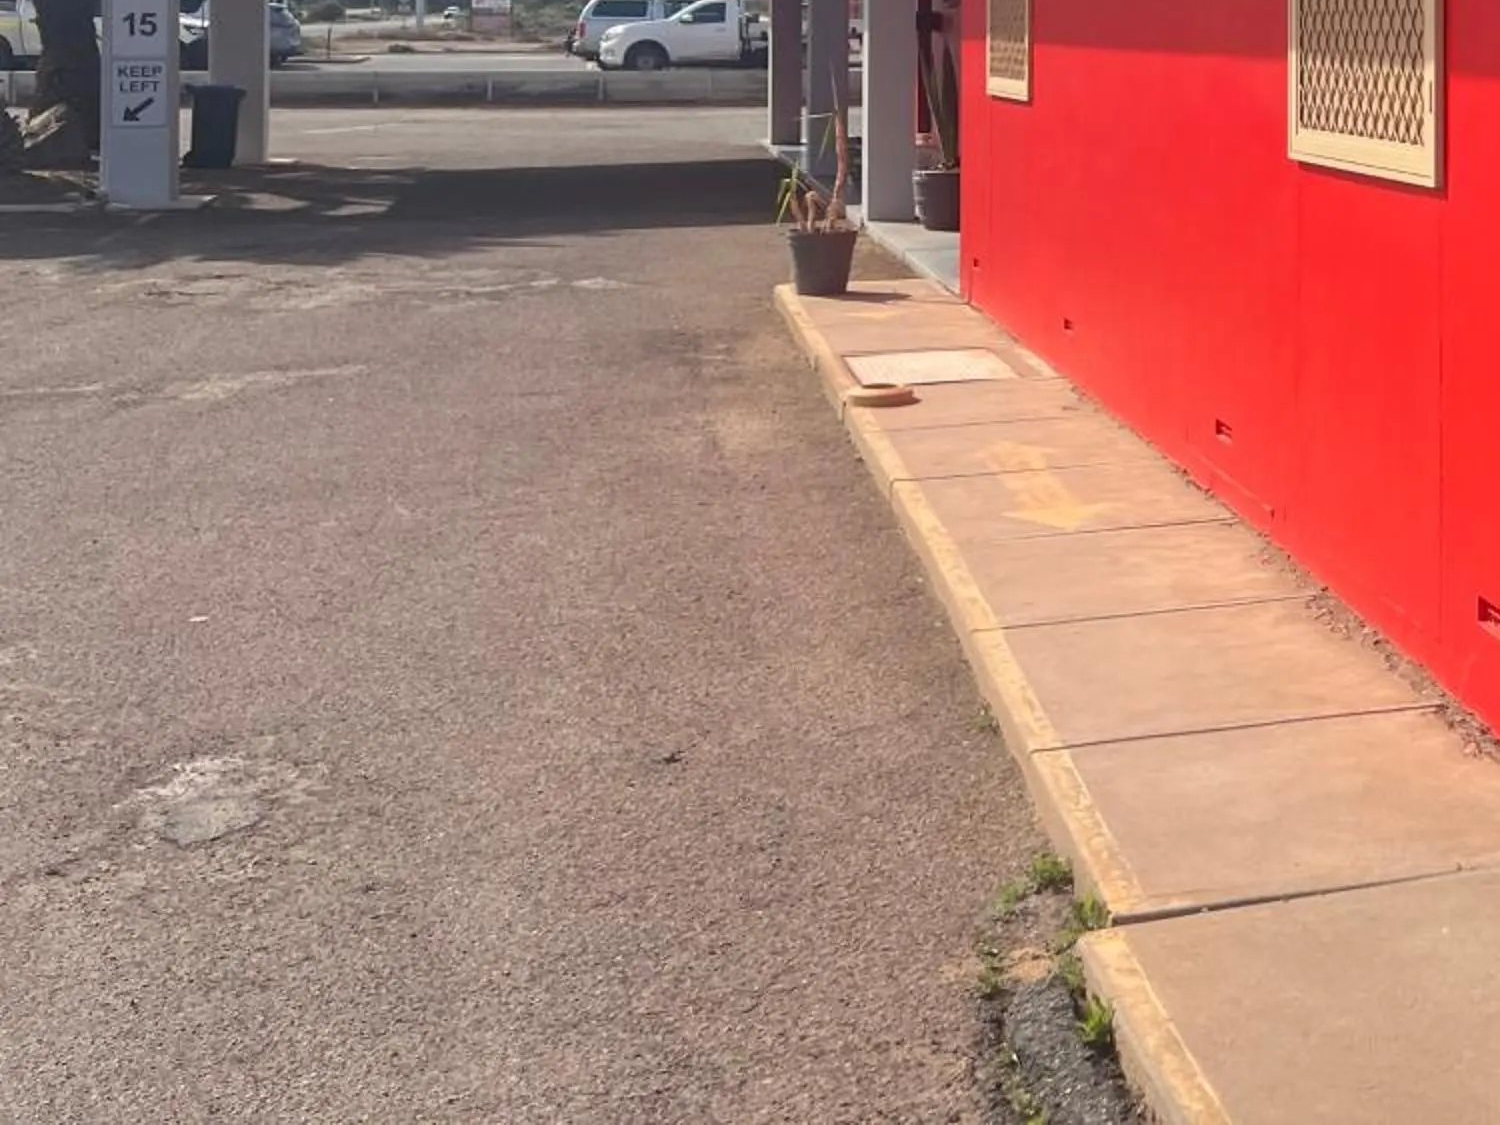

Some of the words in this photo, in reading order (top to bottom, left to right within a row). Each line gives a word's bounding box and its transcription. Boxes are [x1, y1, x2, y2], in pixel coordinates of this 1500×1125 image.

[122, 11, 158, 37] 15
[117, 65, 163, 78] KEEP
[119, 80, 160, 93] LEFT
